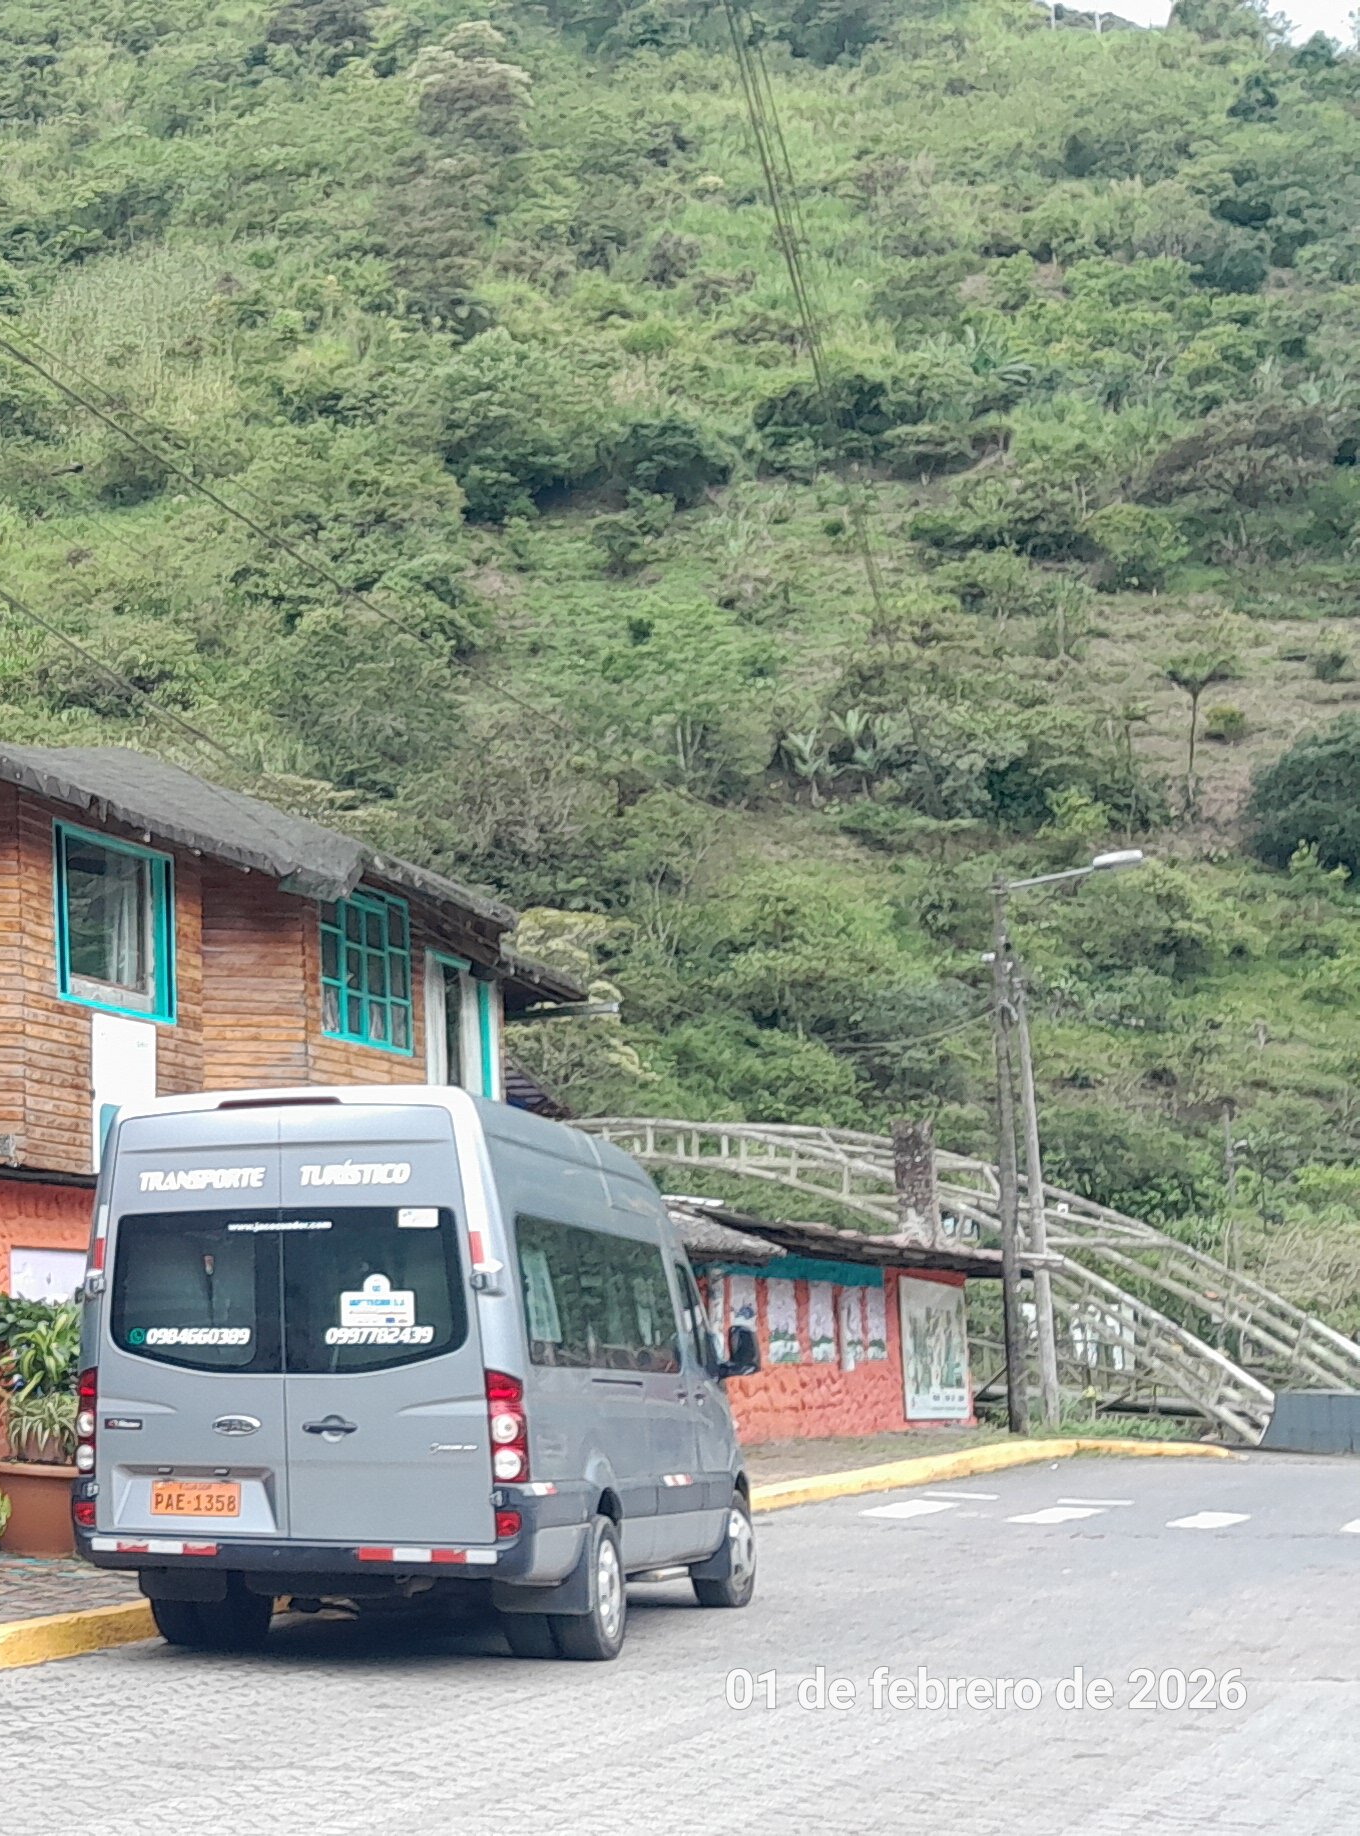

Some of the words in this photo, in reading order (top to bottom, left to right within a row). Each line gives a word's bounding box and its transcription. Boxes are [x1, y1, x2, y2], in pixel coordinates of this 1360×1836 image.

[139, 1167, 265, 1191] TRANSPORTE
[300, 1159, 410, 1186] TURÍSTICO
[146, 1328, 251, 1345] 0984660389
[325, 1326, 434, 1345] 0997782439
[154, 1493, 237, 1512] PAE-1358
